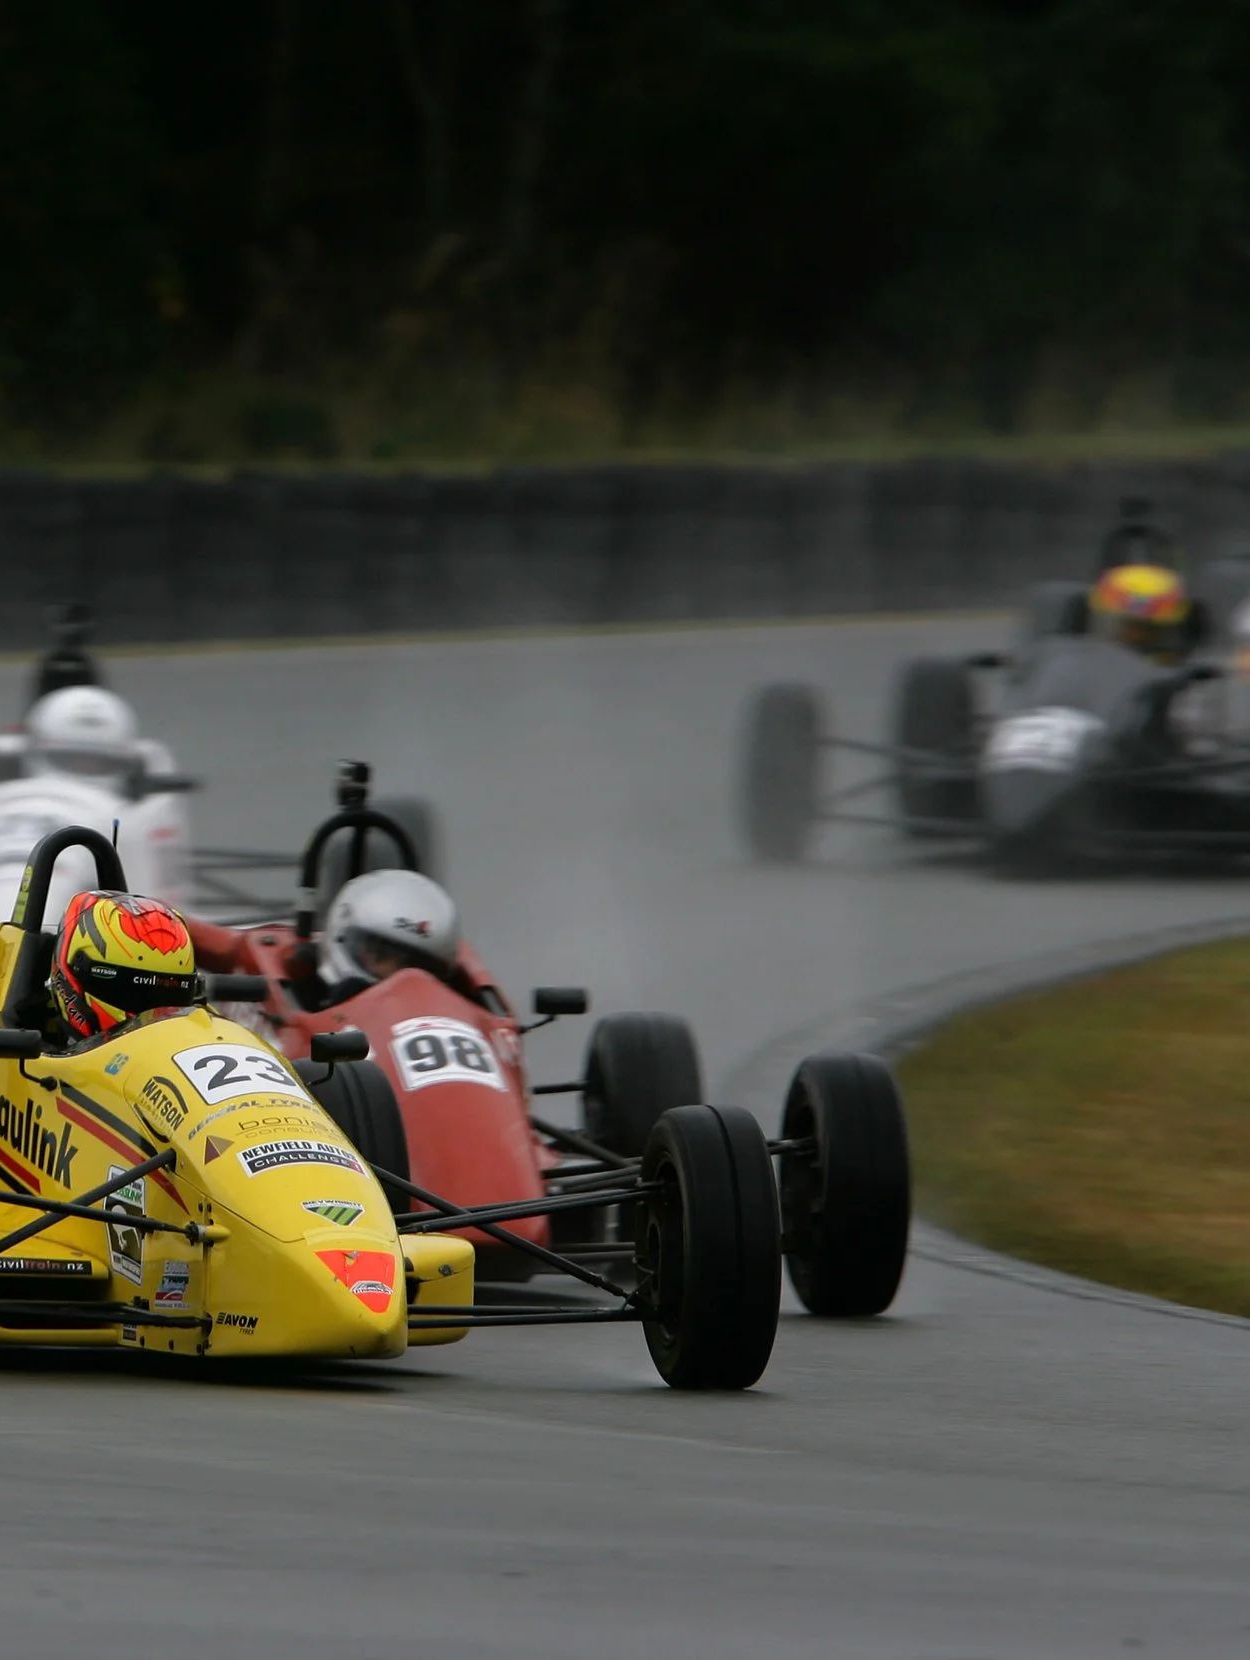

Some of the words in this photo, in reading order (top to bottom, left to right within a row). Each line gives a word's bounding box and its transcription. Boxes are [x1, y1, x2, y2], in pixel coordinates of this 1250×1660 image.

[405, 1034, 492, 1074] 98
[193, 1055, 297, 1091] 23
[142, 1078, 185, 1131] WATSON
[188, 1100, 261, 1140] GENERAL
[268, 1098, 322, 1116] TYRES
[241, 1140, 312, 1161] NEWFIELD
[253, 1151, 350, 1169] CHALLENGE
[224, 1313, 259, 1328] AVON
